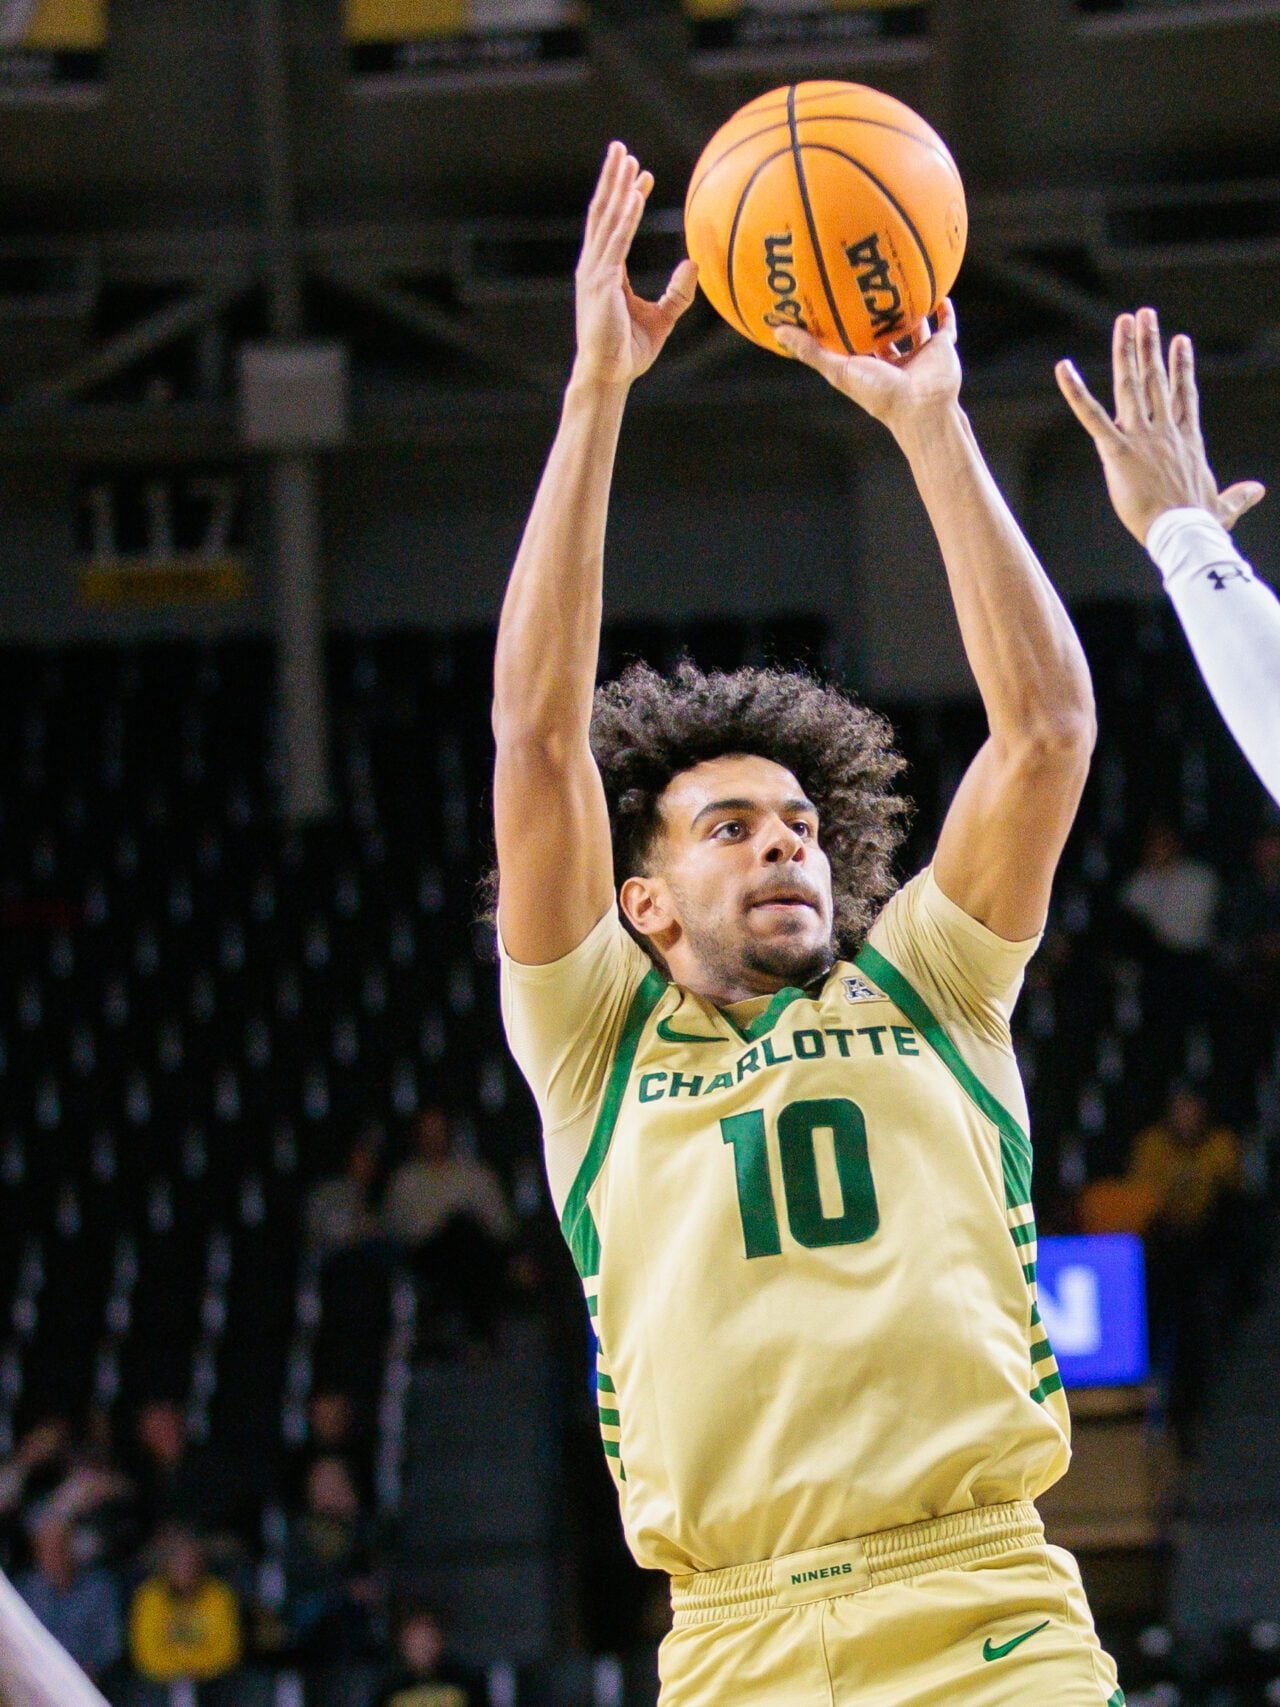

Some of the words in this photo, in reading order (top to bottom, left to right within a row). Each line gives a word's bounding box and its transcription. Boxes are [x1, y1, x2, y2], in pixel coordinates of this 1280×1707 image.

[763, 233, 808, 331] son
[845, 231, 905, 340] NCAA
[86, 478, 234, 559] 117
[638, 1025, 920, 1104] CHARLOTTE
[719, 1097, 880, 1260] 10
[790, 1562, 853, 1585] NINERS
